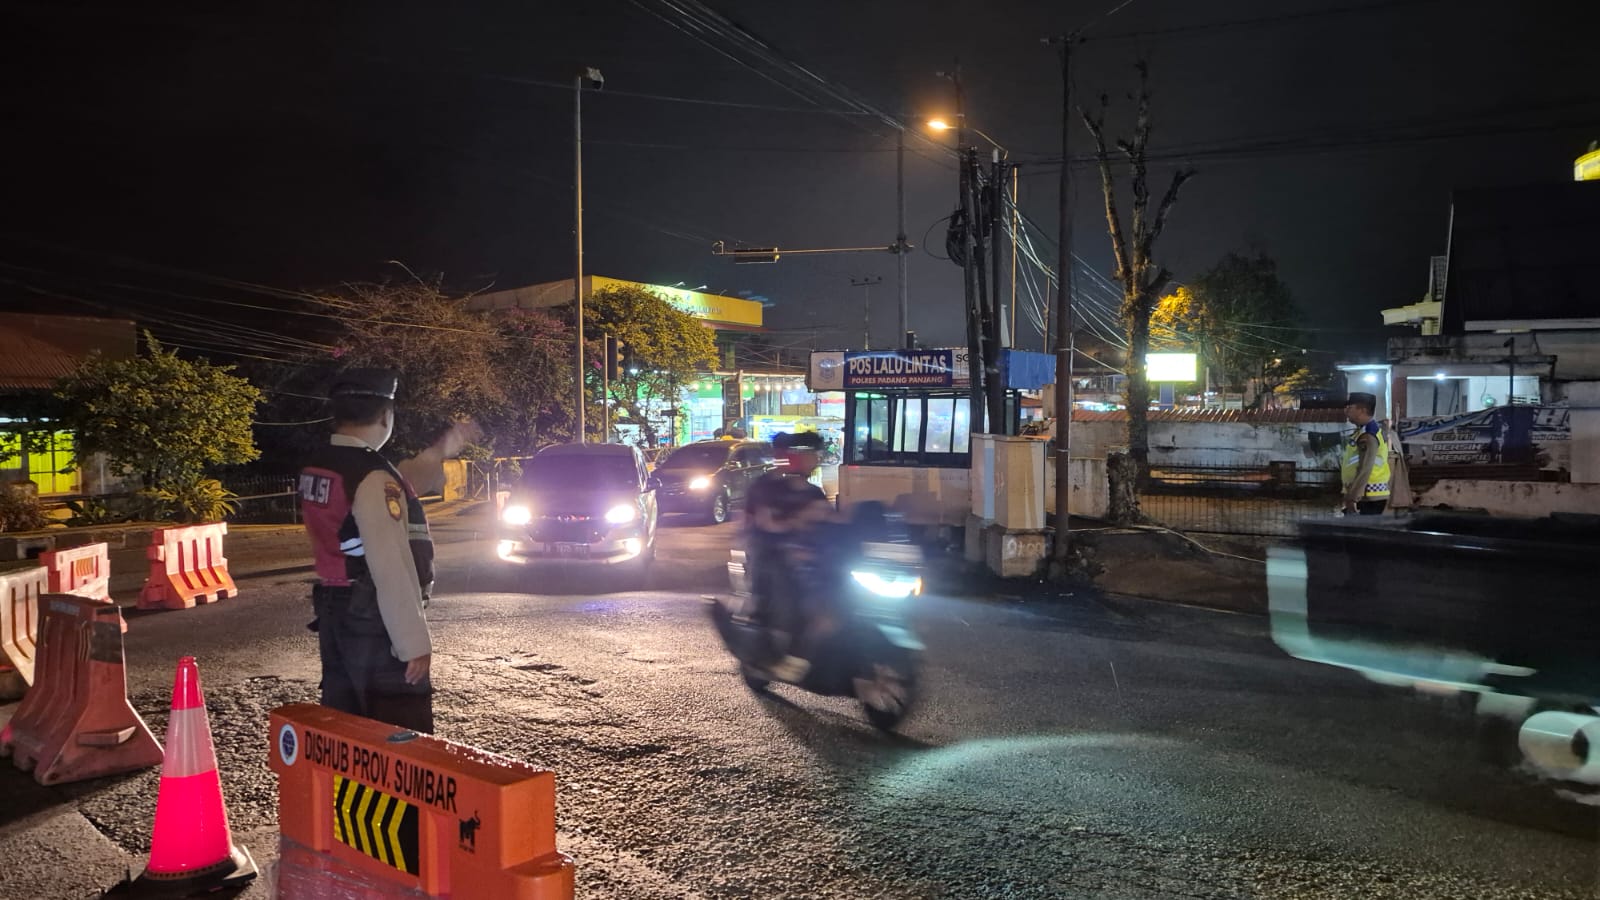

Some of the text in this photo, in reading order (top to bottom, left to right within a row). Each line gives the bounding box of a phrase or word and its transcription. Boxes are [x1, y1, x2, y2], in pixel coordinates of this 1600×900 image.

[849, 354, 946, 374] POS LALU LINTAS
[851, 377, 876, 385] POLRES
[909, 376, 943, 384] PANJANG
[305, 731, 458, 814] DISHUB PROV. SUMBAR
